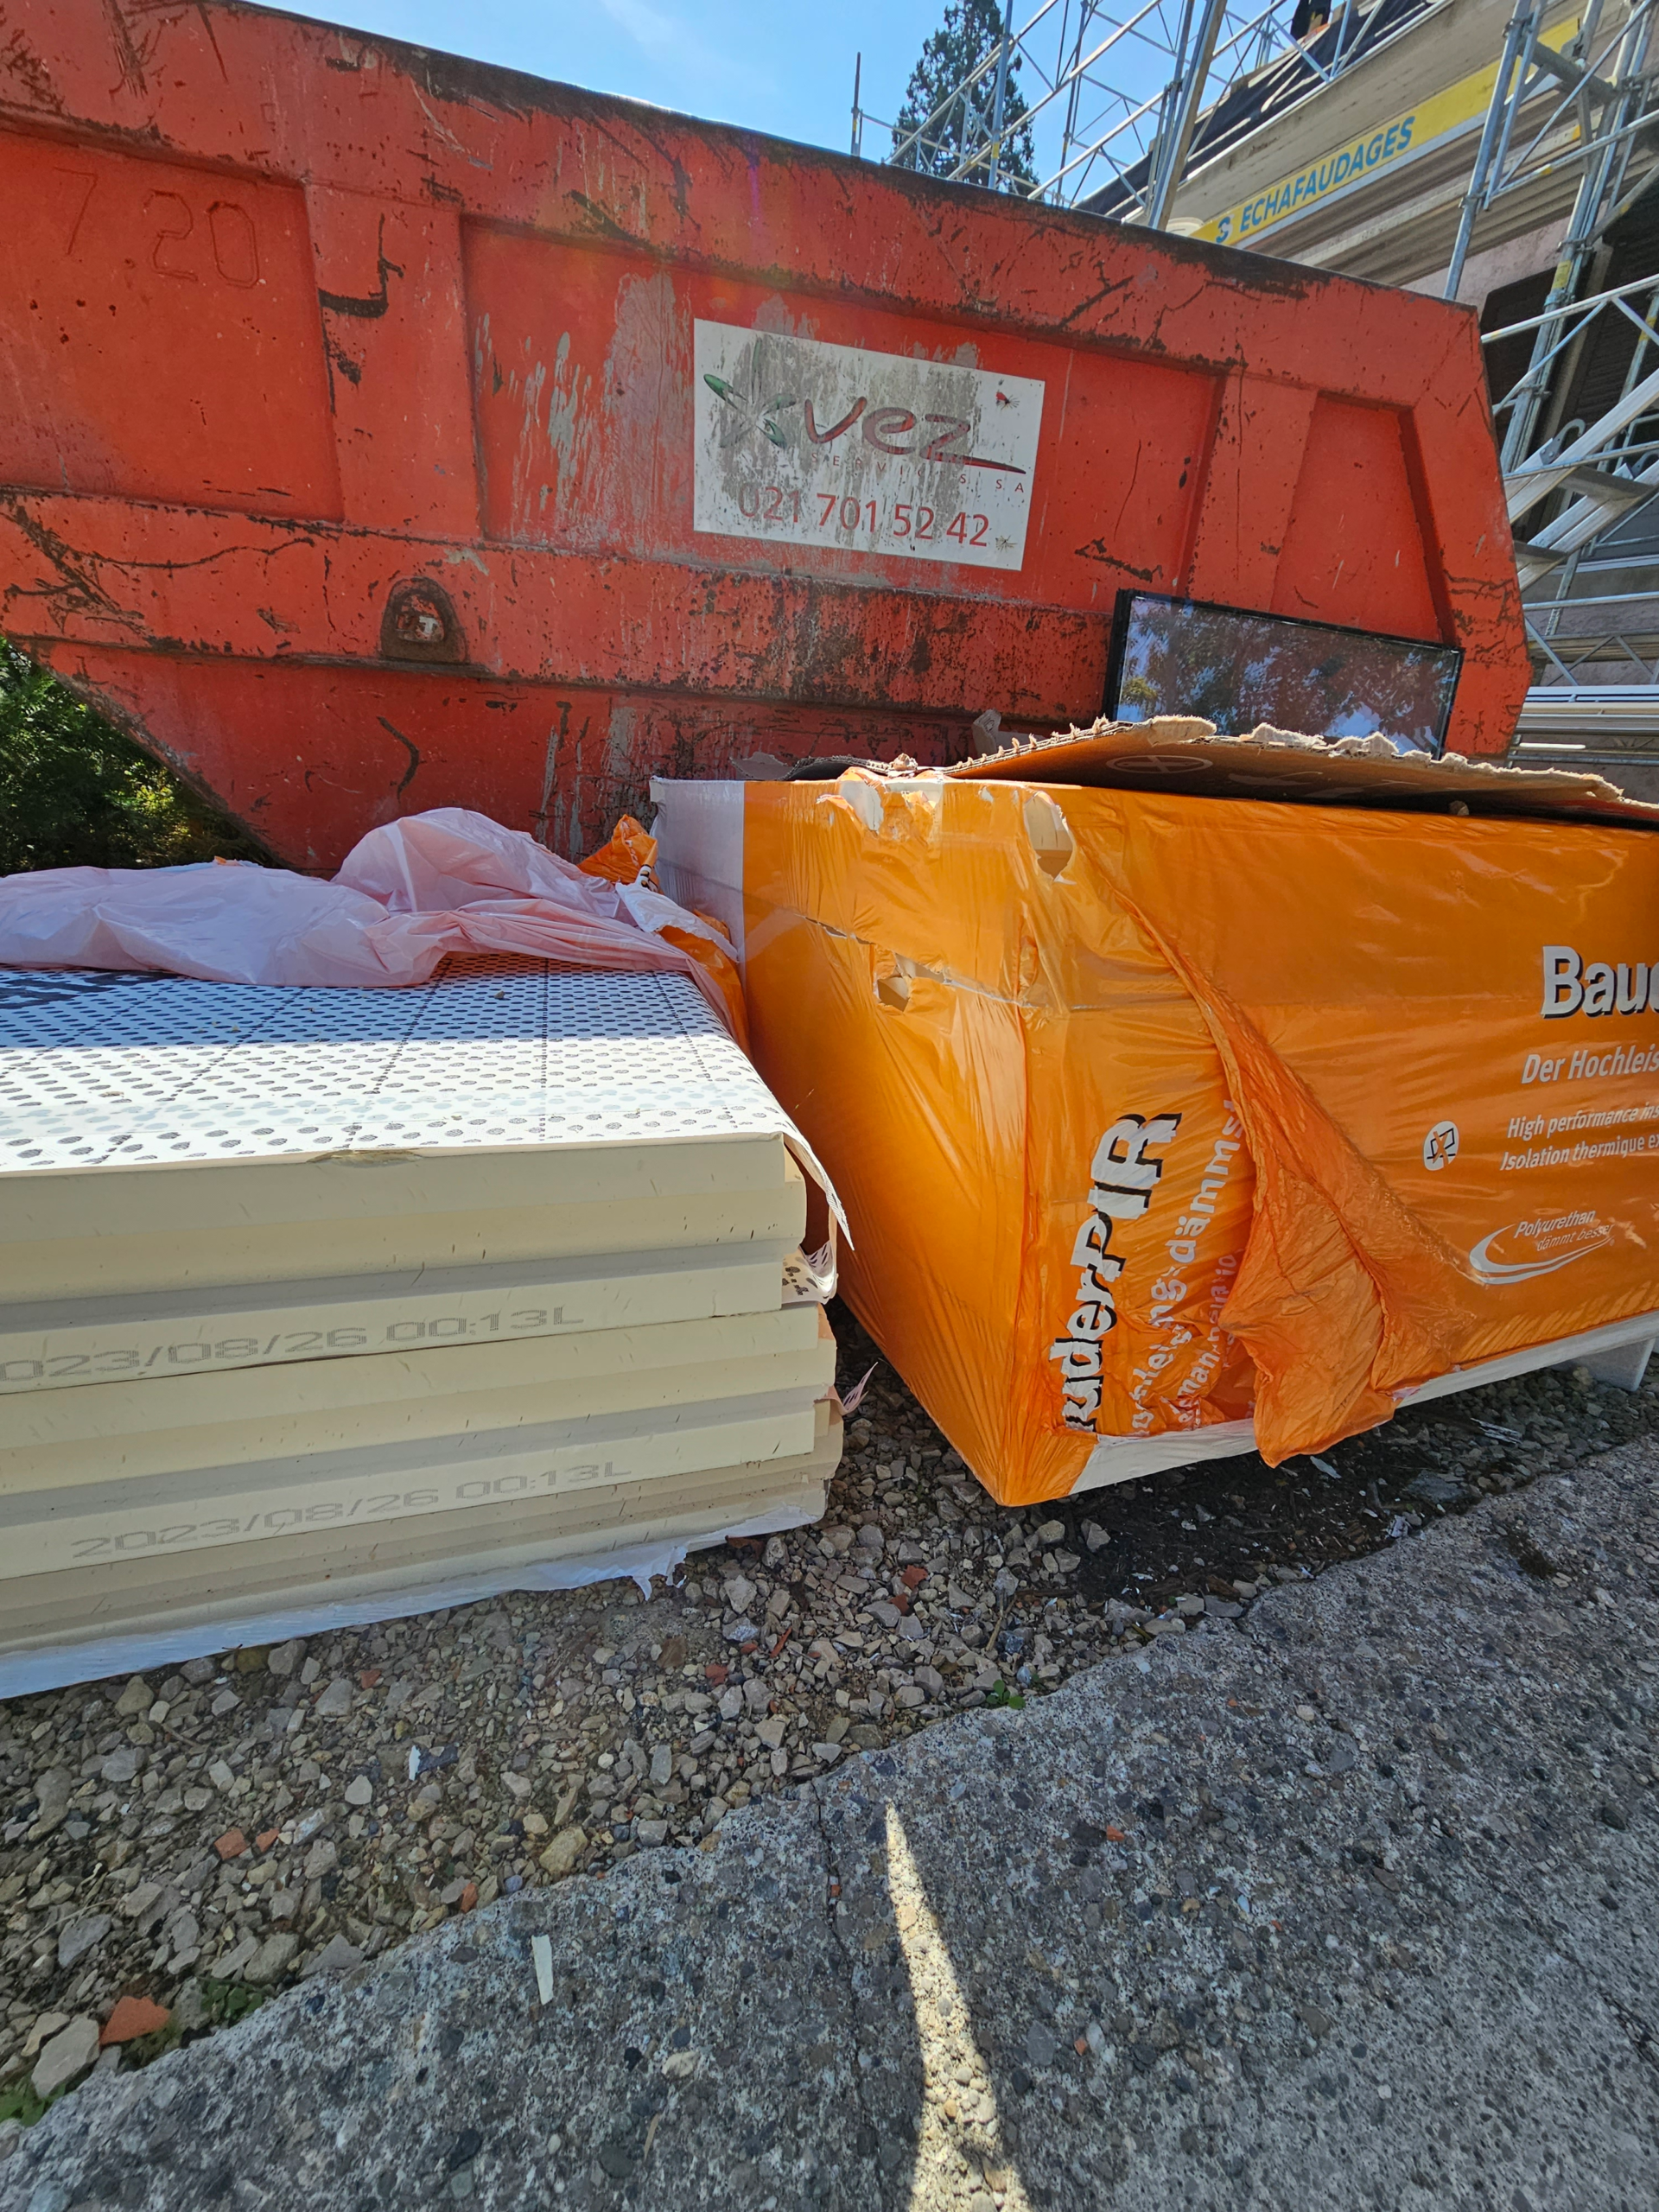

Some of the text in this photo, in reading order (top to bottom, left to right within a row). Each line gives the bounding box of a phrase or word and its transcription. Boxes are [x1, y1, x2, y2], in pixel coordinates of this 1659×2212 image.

[1239, 116, 1415, 233] ECHAFAUDAGES
[811, 452, 1024, 493] SERVIS SA
[737, 484, 989, 548] 021 701 52 42
[1521, 1053, 1567, 1084] Der
[1507, 1114, 1545, 1141] High
[1547, 1107, 1639, 1139] performance
[1499, 1145, 1570, 1171] Isolation
[1573, 1135, 1645, 1159] thermique
[1514, 1210, 1596, 1239] Polyurethan
[1537, 1224, 1615, 1251] dämmt besser
[386, 1306, 584, 1341] 00:13L
[73, 1461, 632, 1558] 2023/08/26 00:13L
